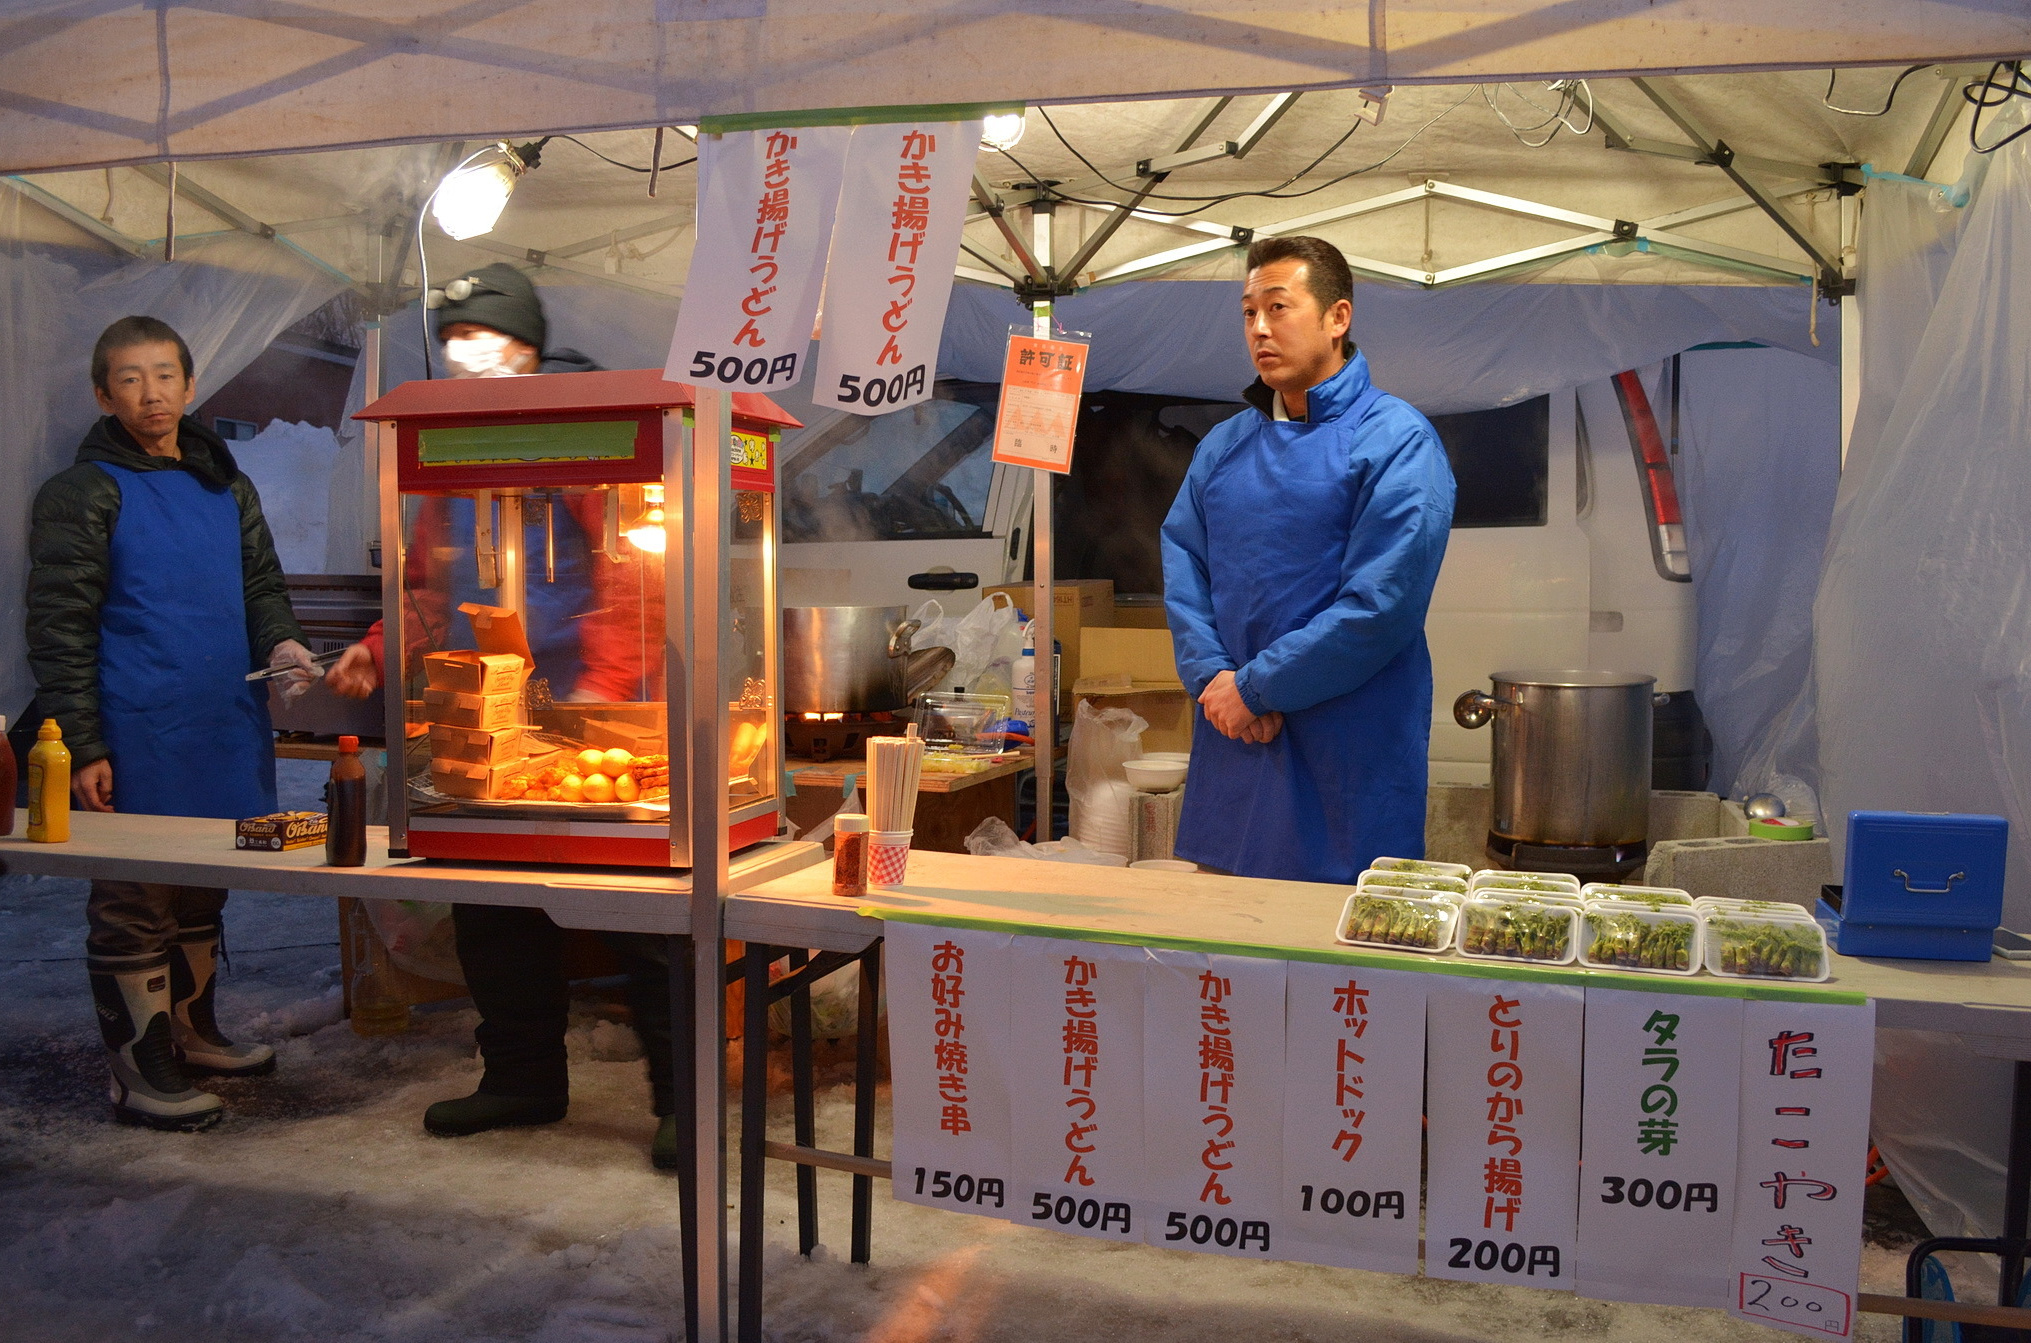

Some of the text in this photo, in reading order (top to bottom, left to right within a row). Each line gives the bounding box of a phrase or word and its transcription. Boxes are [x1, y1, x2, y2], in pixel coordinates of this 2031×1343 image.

[732, 130, 798, 348] かき揚げうどん
[874, 130, 936, 366] かき揚げうどん
[690, 351, 797, 385] 500円
[837, 364, 926, 407] 500円
[1020, 348, 1074, 371] 許可証
[931, 940, 972, 1136] お好み焼き串
[1062, 955, 1099, 1187] かき揚げうどん
[1331, 980, 1370, 1163] ホットドック
[1637, 1010, 1680, 1156] タラの芽
[1198, 970, 1236, 1206] かき揚げうどん
[1484, 995, 1524, 1233] とりのから揚げ
[914, 1167, 1004, 1208] 150円
[1601, 1176, 1718, 1213] 300円
[1760, 1030, 1838, 1279] たこやき
[1031, 1192, 1131, 1234] 500円
[1165, 1211, 1270, 1252] 500円
[1301, 1185, 1404, 1219] 100円
[1448, 1237, 1561, 1278] 200円
